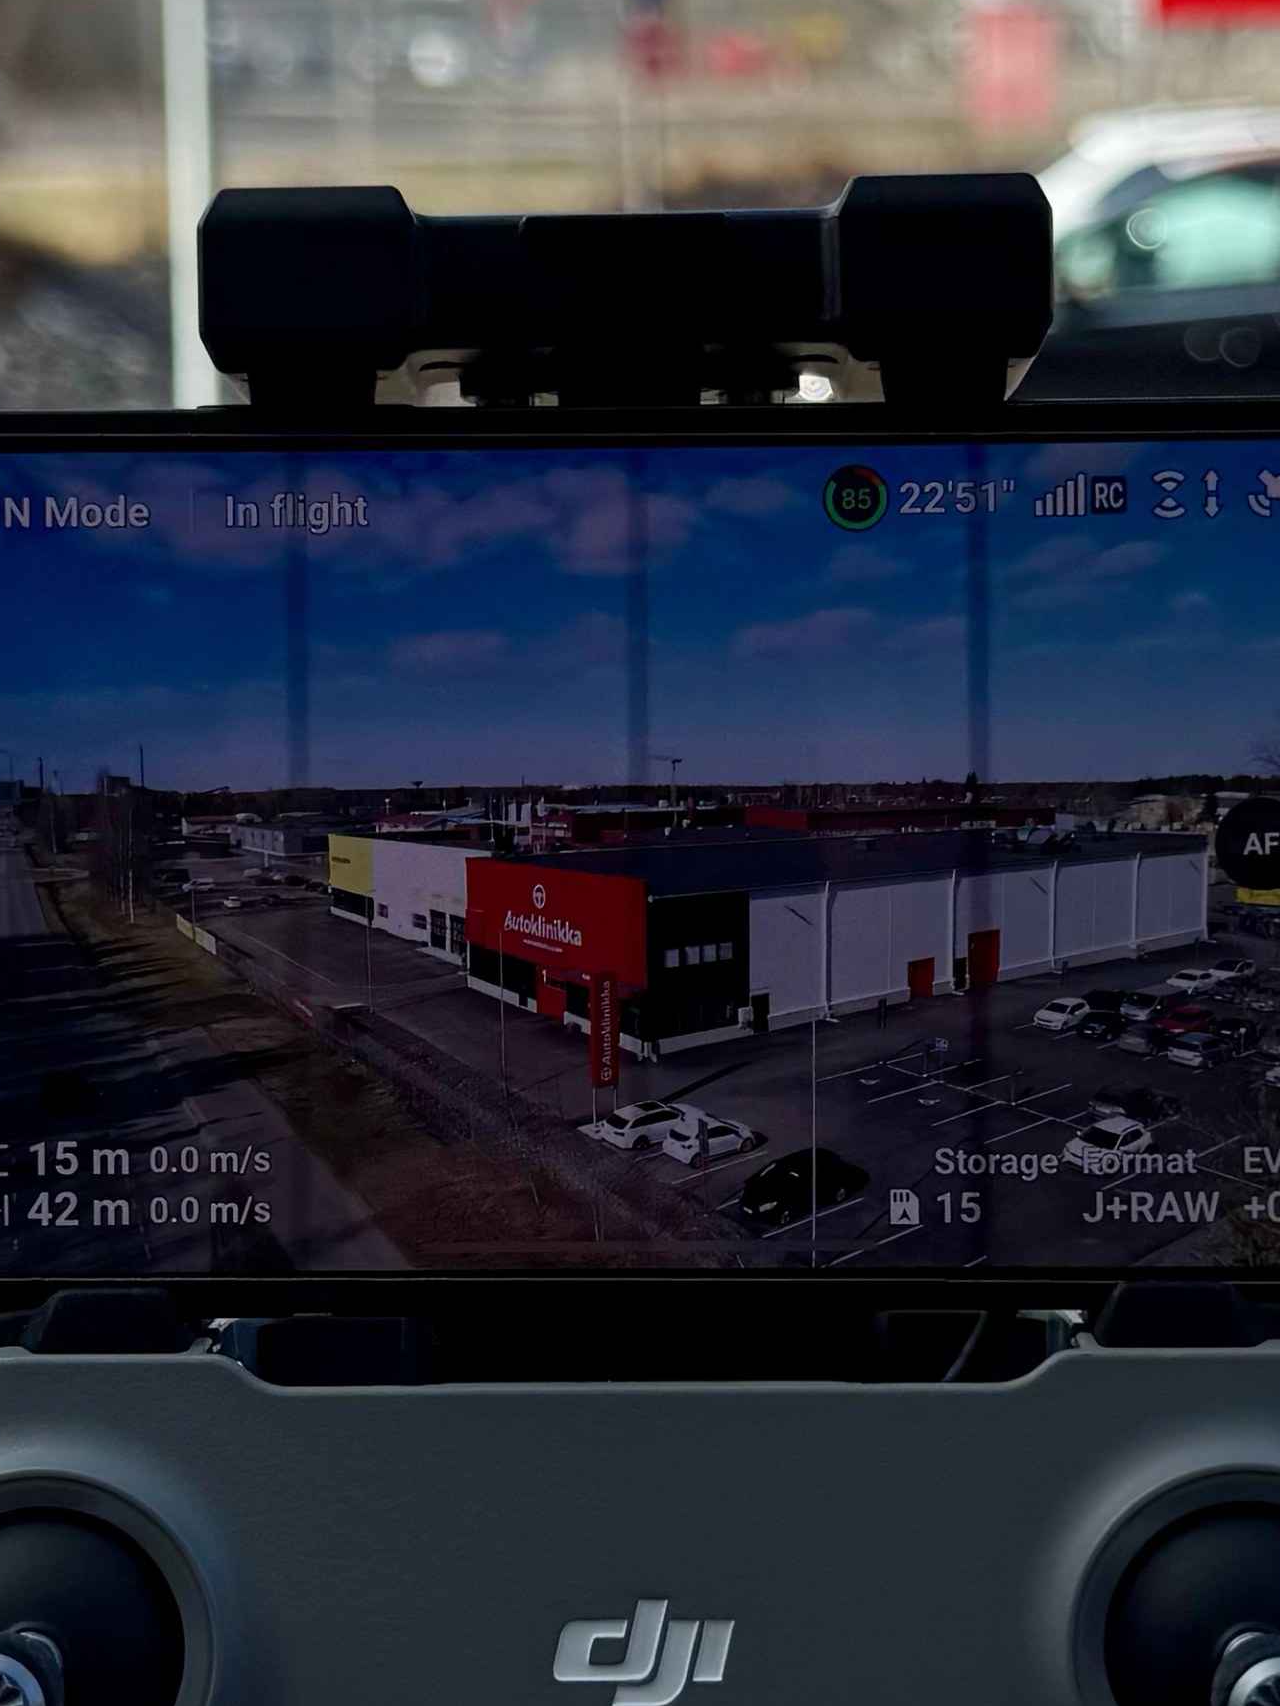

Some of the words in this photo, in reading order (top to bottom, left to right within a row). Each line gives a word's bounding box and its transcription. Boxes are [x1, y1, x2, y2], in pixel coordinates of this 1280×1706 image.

[4, 497, 30, 528] N
[46, 495, 151, 528] Mode
[842, 488, 872, 510] 85
[1094, 481, 1124, 509] RC
[226, 495, 259, 527] In
[270, 493, 369, 534] flight
[1243, 832, 1280, 855] AF
[503, 910, 582, 946] Autoklinikka
[28, 1141, 79, 1175] 15
[93, 1148, 130, 1175] m
[150, 1146, 200, 1174] 0.0
[210, 1146, 272, 1177] m/s
[933, 1146, 1059, 1182] Storage
[1082, 1147, 1197, 1175] Format
[28, 1192, 79, 1225] 42
[93, 1199, 130, 1225] m
[150, 1196, 200, 1224] 0.0
[210, 1196, 272, 1227] m/s
[936, 1192, 982, 1224] 15
[1083, 1191, 1218, 1224] J+RAW
